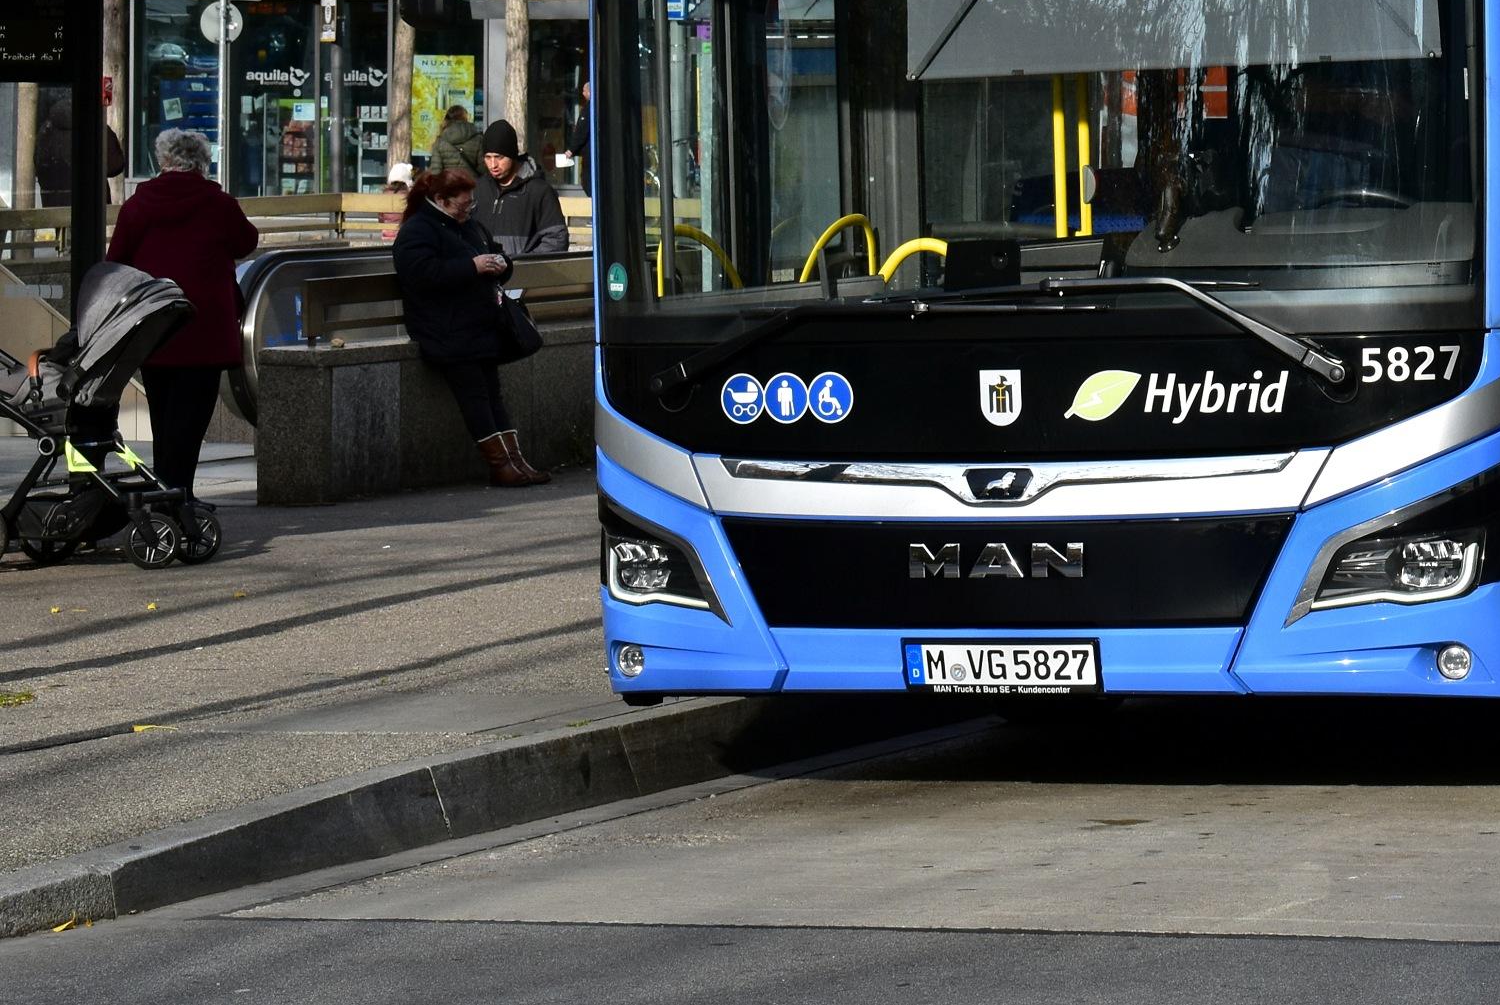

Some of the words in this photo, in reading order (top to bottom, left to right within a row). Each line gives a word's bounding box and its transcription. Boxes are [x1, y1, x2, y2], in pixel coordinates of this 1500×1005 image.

[246, 69, 289, 85] aquila
[1361, 345, 1461, 382] 5827
[1143, 369, 1289, 424] Hybrid
[909, 543, 1084, 578] MAN
[912, 668, 920, 678] D
[926, 649, 946, 680] M
[966, 649, 1007, 680] VG
[1012, 649, 1089, 681] 5827
[933, 685, 951, 693] MAN
[953, 685, 974, 693] Truck
[975, 685, 981, 693] &
[983, 685, 998, 694] Bus
[999, 686, 1010, 694] SE
[1018, 686, 1070, 694] Kundencenter
